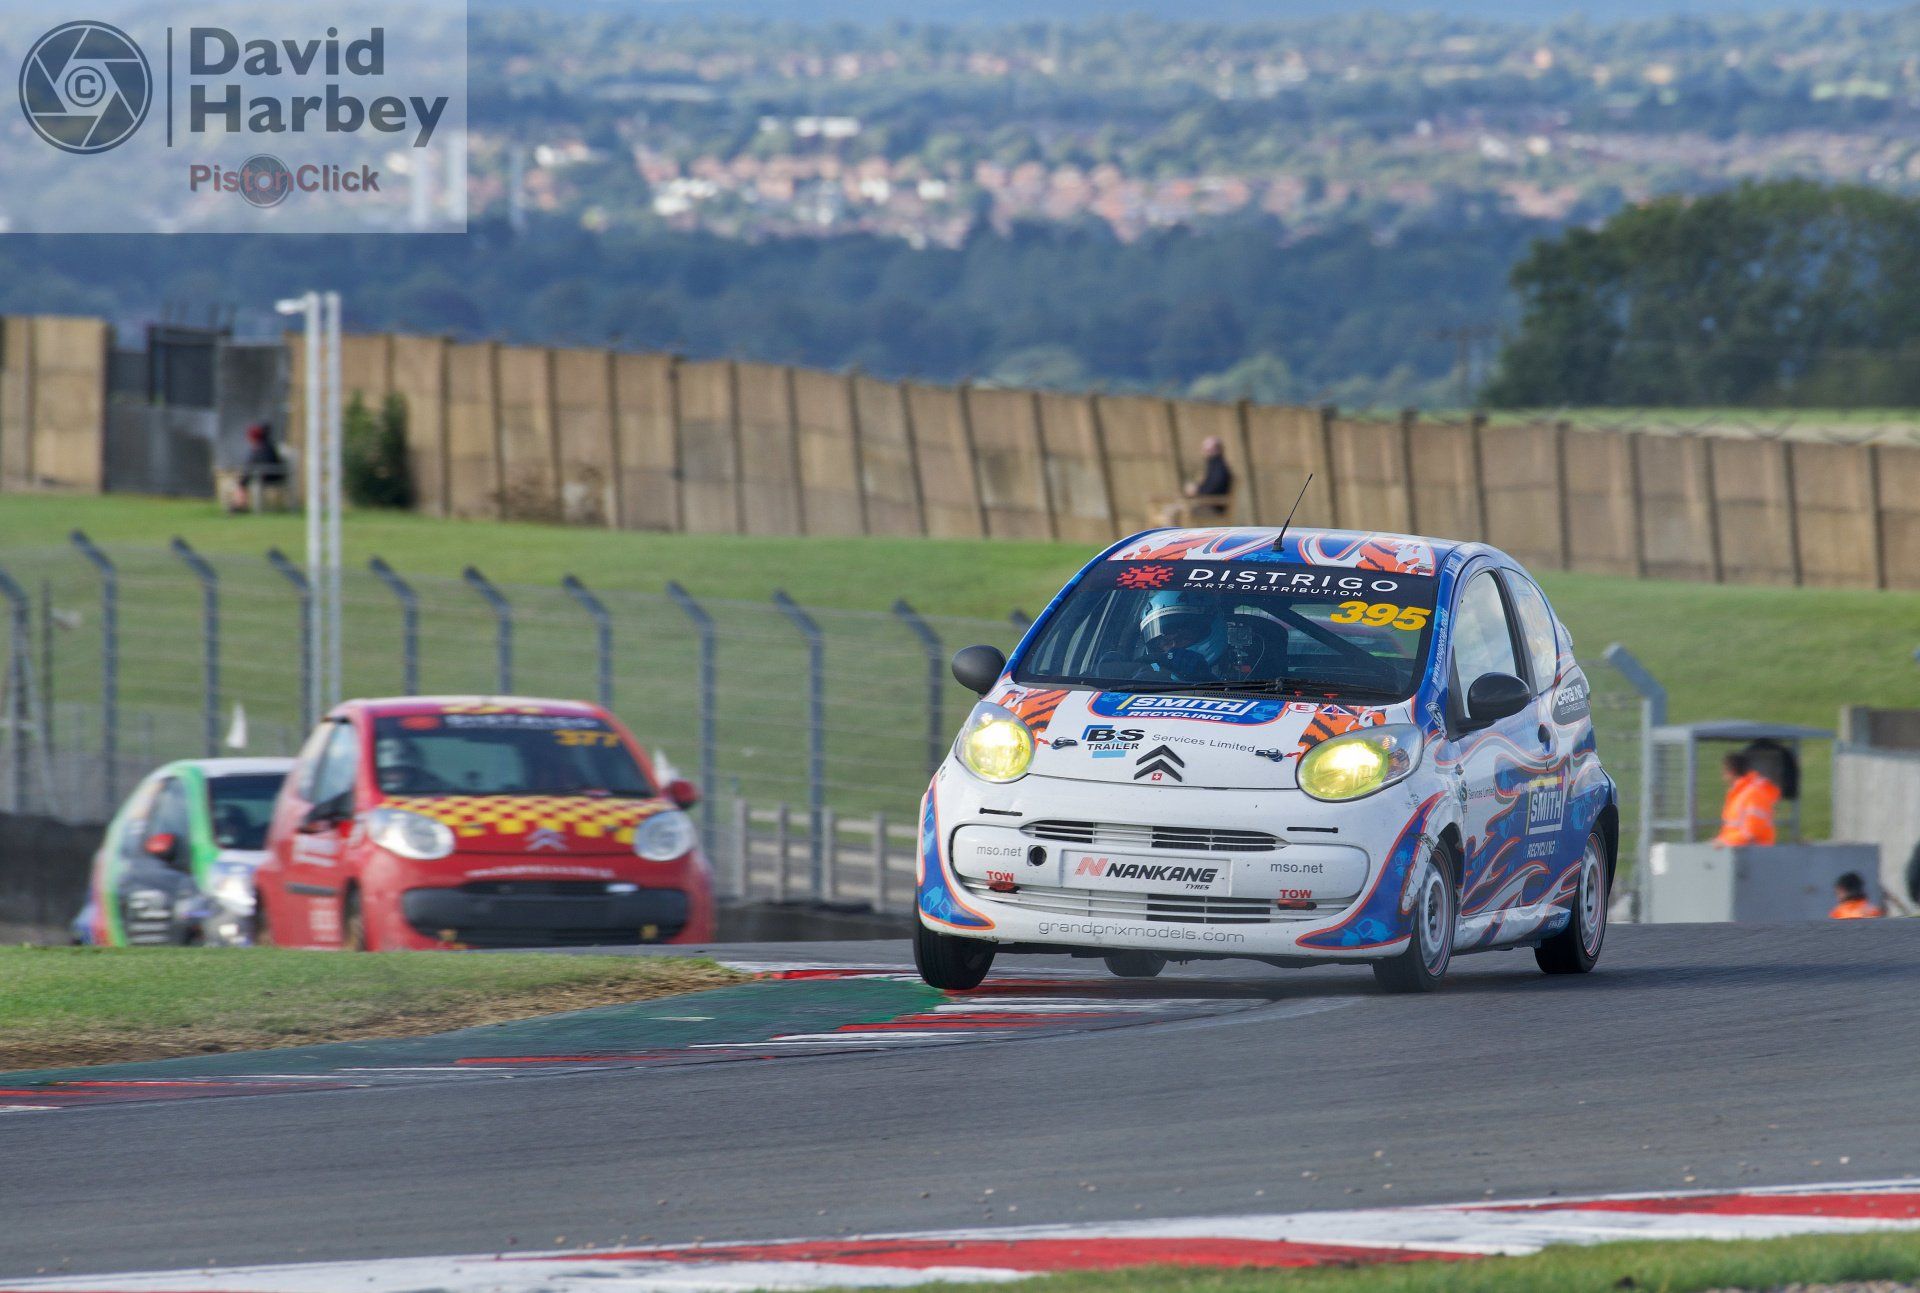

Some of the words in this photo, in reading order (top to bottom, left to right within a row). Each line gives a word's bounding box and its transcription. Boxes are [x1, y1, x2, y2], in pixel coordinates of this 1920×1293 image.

[1187, 568, 1399, 592] DISTRIGO
[1241, 584, 1363, 597] DISTRIBUTION
[1329, 600, 1432, 631] 395
[1131, 696, 1245, 713] SMITH
[1127, 710, 1224, 721] RECYCLING
[1086, 728, 1146, 742] BS
[1152, 733, 1205, 746] Services
[1209, 739, 1256, 753] Limited
[1087, 742, 1140, 751] TRAILER
[1530, 790, 1562, 823] SMITH
[976, 846, 1022, 857] mso.net
[1527, 840, 1556, 858] RECYCLING
[1105, 862, 1219, 883] NANKANG
[1270, 862, 1324, 874] mso.net
[986, 870, 1015, 882] TOW
[1184, 883, 1210, 891] TYRES
[1279, 889, 1312, 899] TOW
[1038, 920, 1245, 943] grandprixmodels.com
